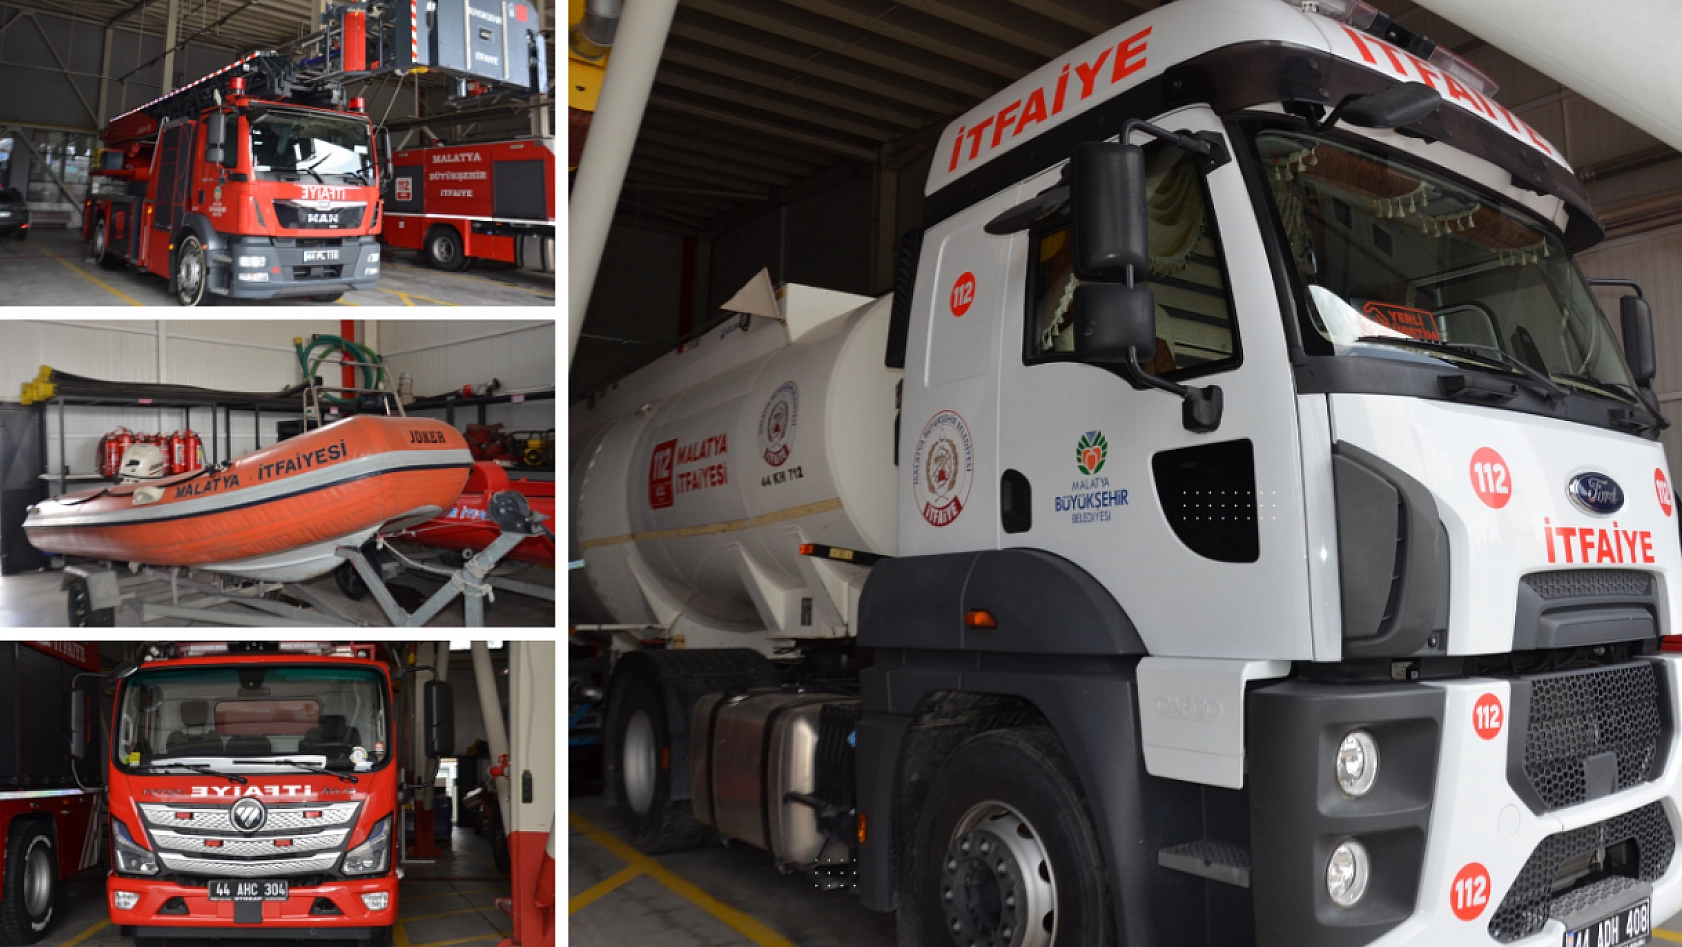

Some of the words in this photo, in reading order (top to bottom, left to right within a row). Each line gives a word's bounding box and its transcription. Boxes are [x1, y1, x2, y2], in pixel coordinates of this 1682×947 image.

[948, 26, 1153, 173] İTFAİYE
[432, 152, 482, 164] MALATYA
[307, 213, 338, 223] MAN
[953, 281, 973, 309] 112
[1388, 310, 1424, 327] YERLİ
[409, 429, 446, 444] JOKER
[676, 433, 728, 466] MALATYA
[258, 438, 348, 481] İTFAİYESİ
[654, 446, 672, 482] 112
[175, 474, 240, 499] MALATYA
[676, 461, 729, 495] İTFAİYESİ
[788, 466, 804, 481] 712
[1071, 476, 1110, 491] MALATYA
[1474, 462, 1509, 494] 112
[1055, 489, 1129, 512] BÜYÜKŞEHİR
[1587, 477, 1618, 505] Ford
[925, 500, 960, 525] İTFAİYE
[1543, 516, 1655, 564] İTFAİYE
[1475, 703, 1501, 730] 112
[216, 882, 231, 896] 44
[237, 882, 258, 896] AHC
[263, 882, 286, 896] 304
[1455, 874, 1488, 911] 112
[1597, 915, 1620, 947] ADH
[1626, 904, 1647, 938] 408
